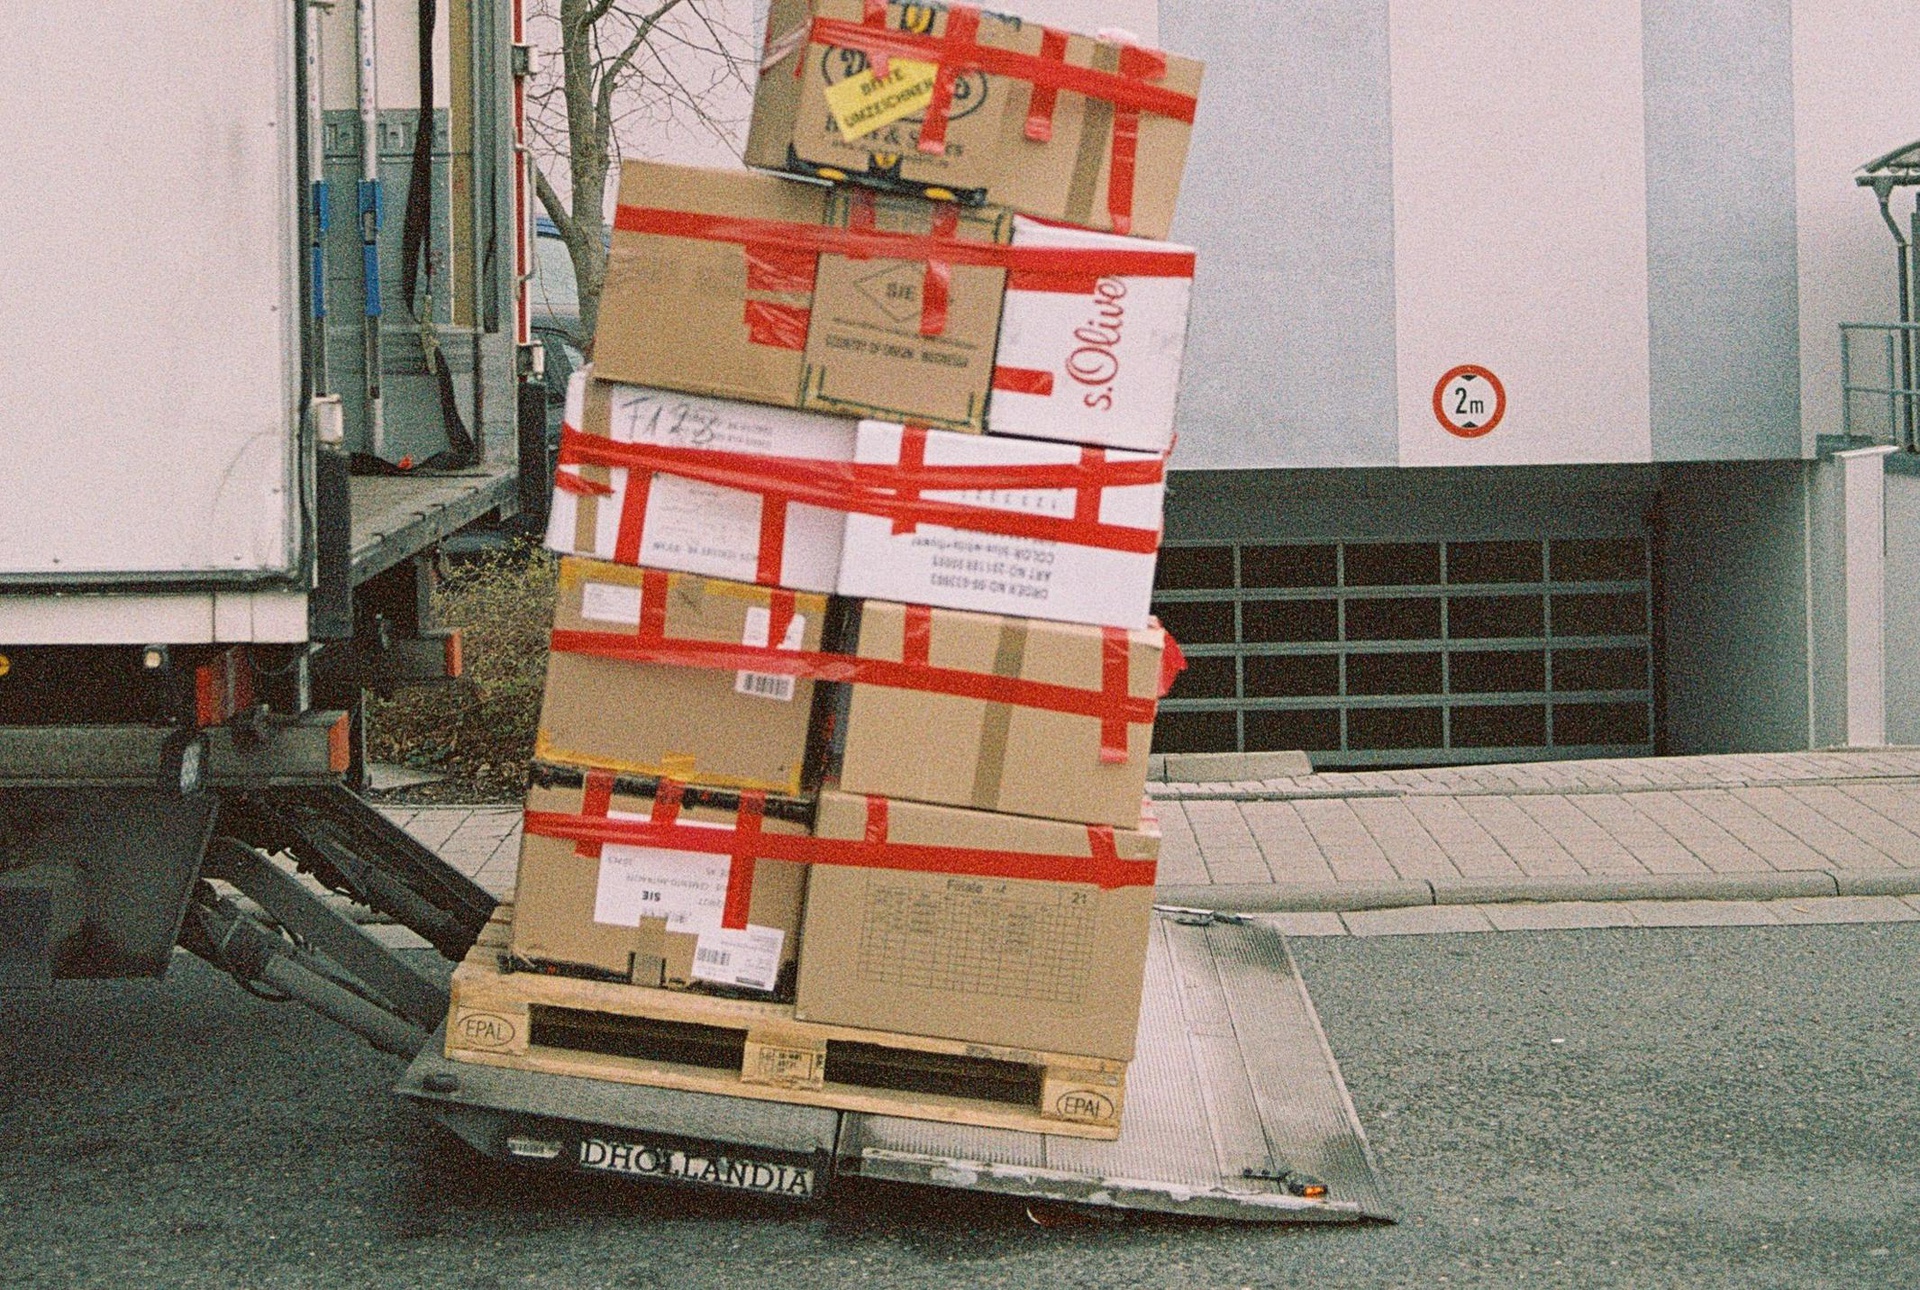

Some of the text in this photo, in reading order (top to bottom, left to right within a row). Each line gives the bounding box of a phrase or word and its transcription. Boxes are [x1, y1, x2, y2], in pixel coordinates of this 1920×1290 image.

[1065, 274, 1127, 412] s.Olive
[1454, 386, 1485, 415] 2m
[641, 889, 662, 903] SIE
[465, 1018, 505, 1041] EPAL
[583, 1140, 809, 1196] DHOLLANDIA
